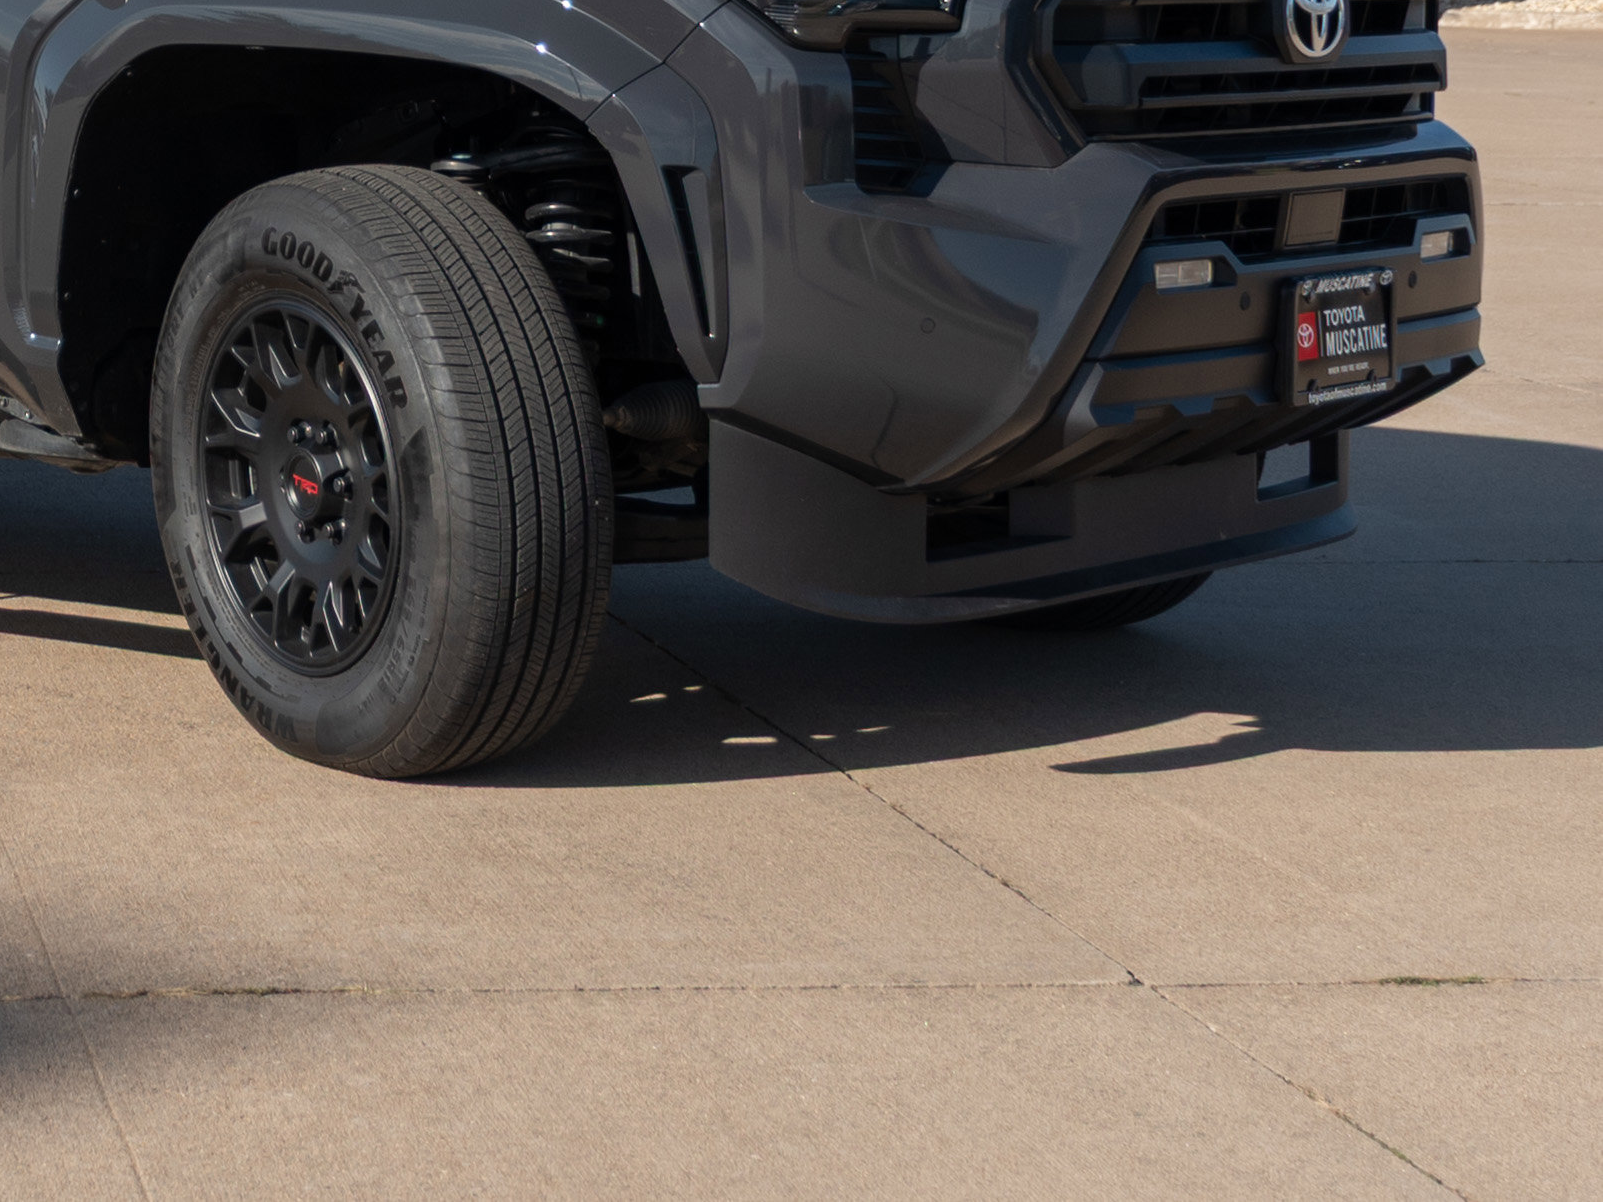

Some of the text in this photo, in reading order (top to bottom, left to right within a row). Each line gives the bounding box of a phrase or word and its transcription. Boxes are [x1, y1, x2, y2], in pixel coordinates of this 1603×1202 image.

[1315, 273, 1375, 293] MUSCATINE
[1323, 305, 1366, 327] TOYOTA
[1325, 323, 1388, 358] MUSCATINE
[169, 560, 298, 742] WRANGLER
